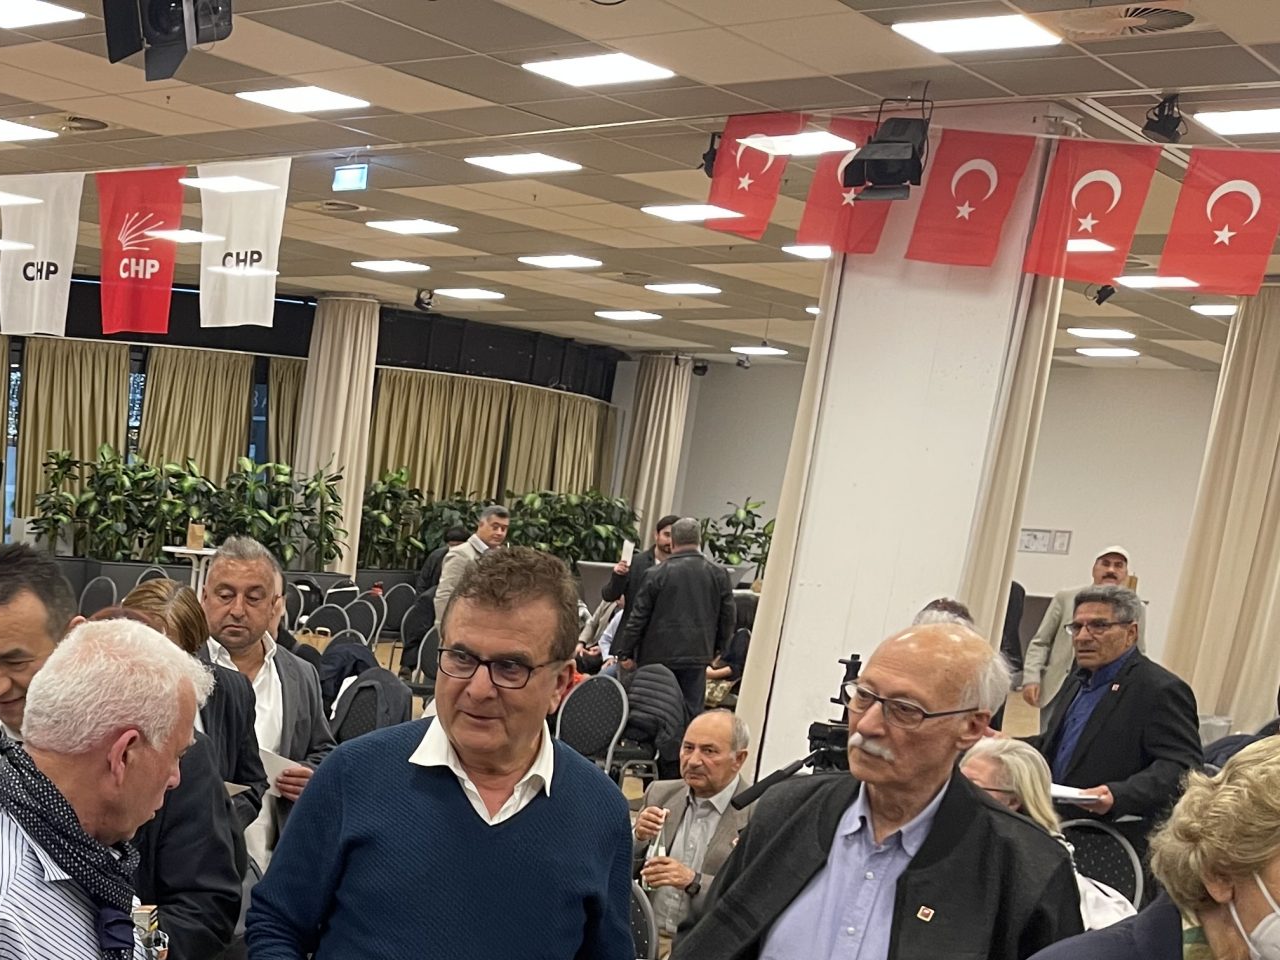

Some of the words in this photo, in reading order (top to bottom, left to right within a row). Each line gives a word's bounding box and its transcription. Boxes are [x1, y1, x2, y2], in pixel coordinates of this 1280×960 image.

[119, 258, 160, 279] CHP
[222, 250, 263, 268] CHP
[23, 261, 58, 281] CHP
